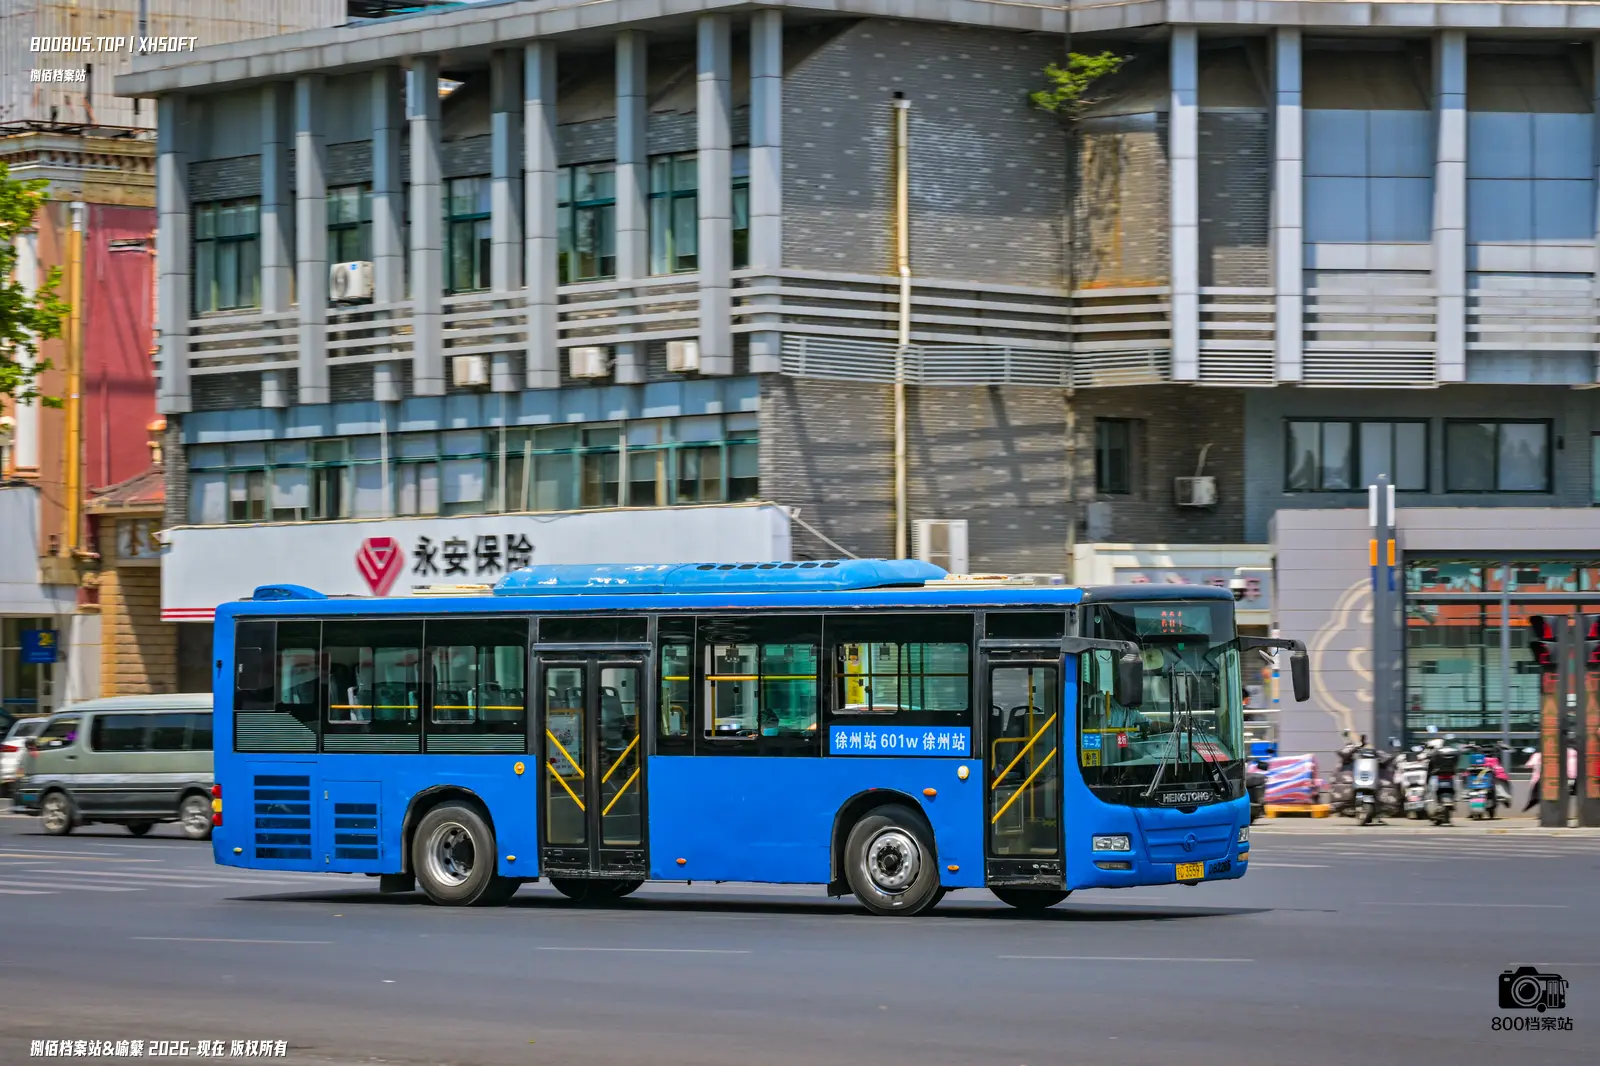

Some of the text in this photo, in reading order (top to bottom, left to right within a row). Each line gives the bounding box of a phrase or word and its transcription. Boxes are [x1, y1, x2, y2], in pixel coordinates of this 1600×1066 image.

[411, 533, 536, 576] 永安保险
[835, 732, 966, 751] 徐州站 601w 徐州站
[1162, 791, 1209, 803] HENGTONG
